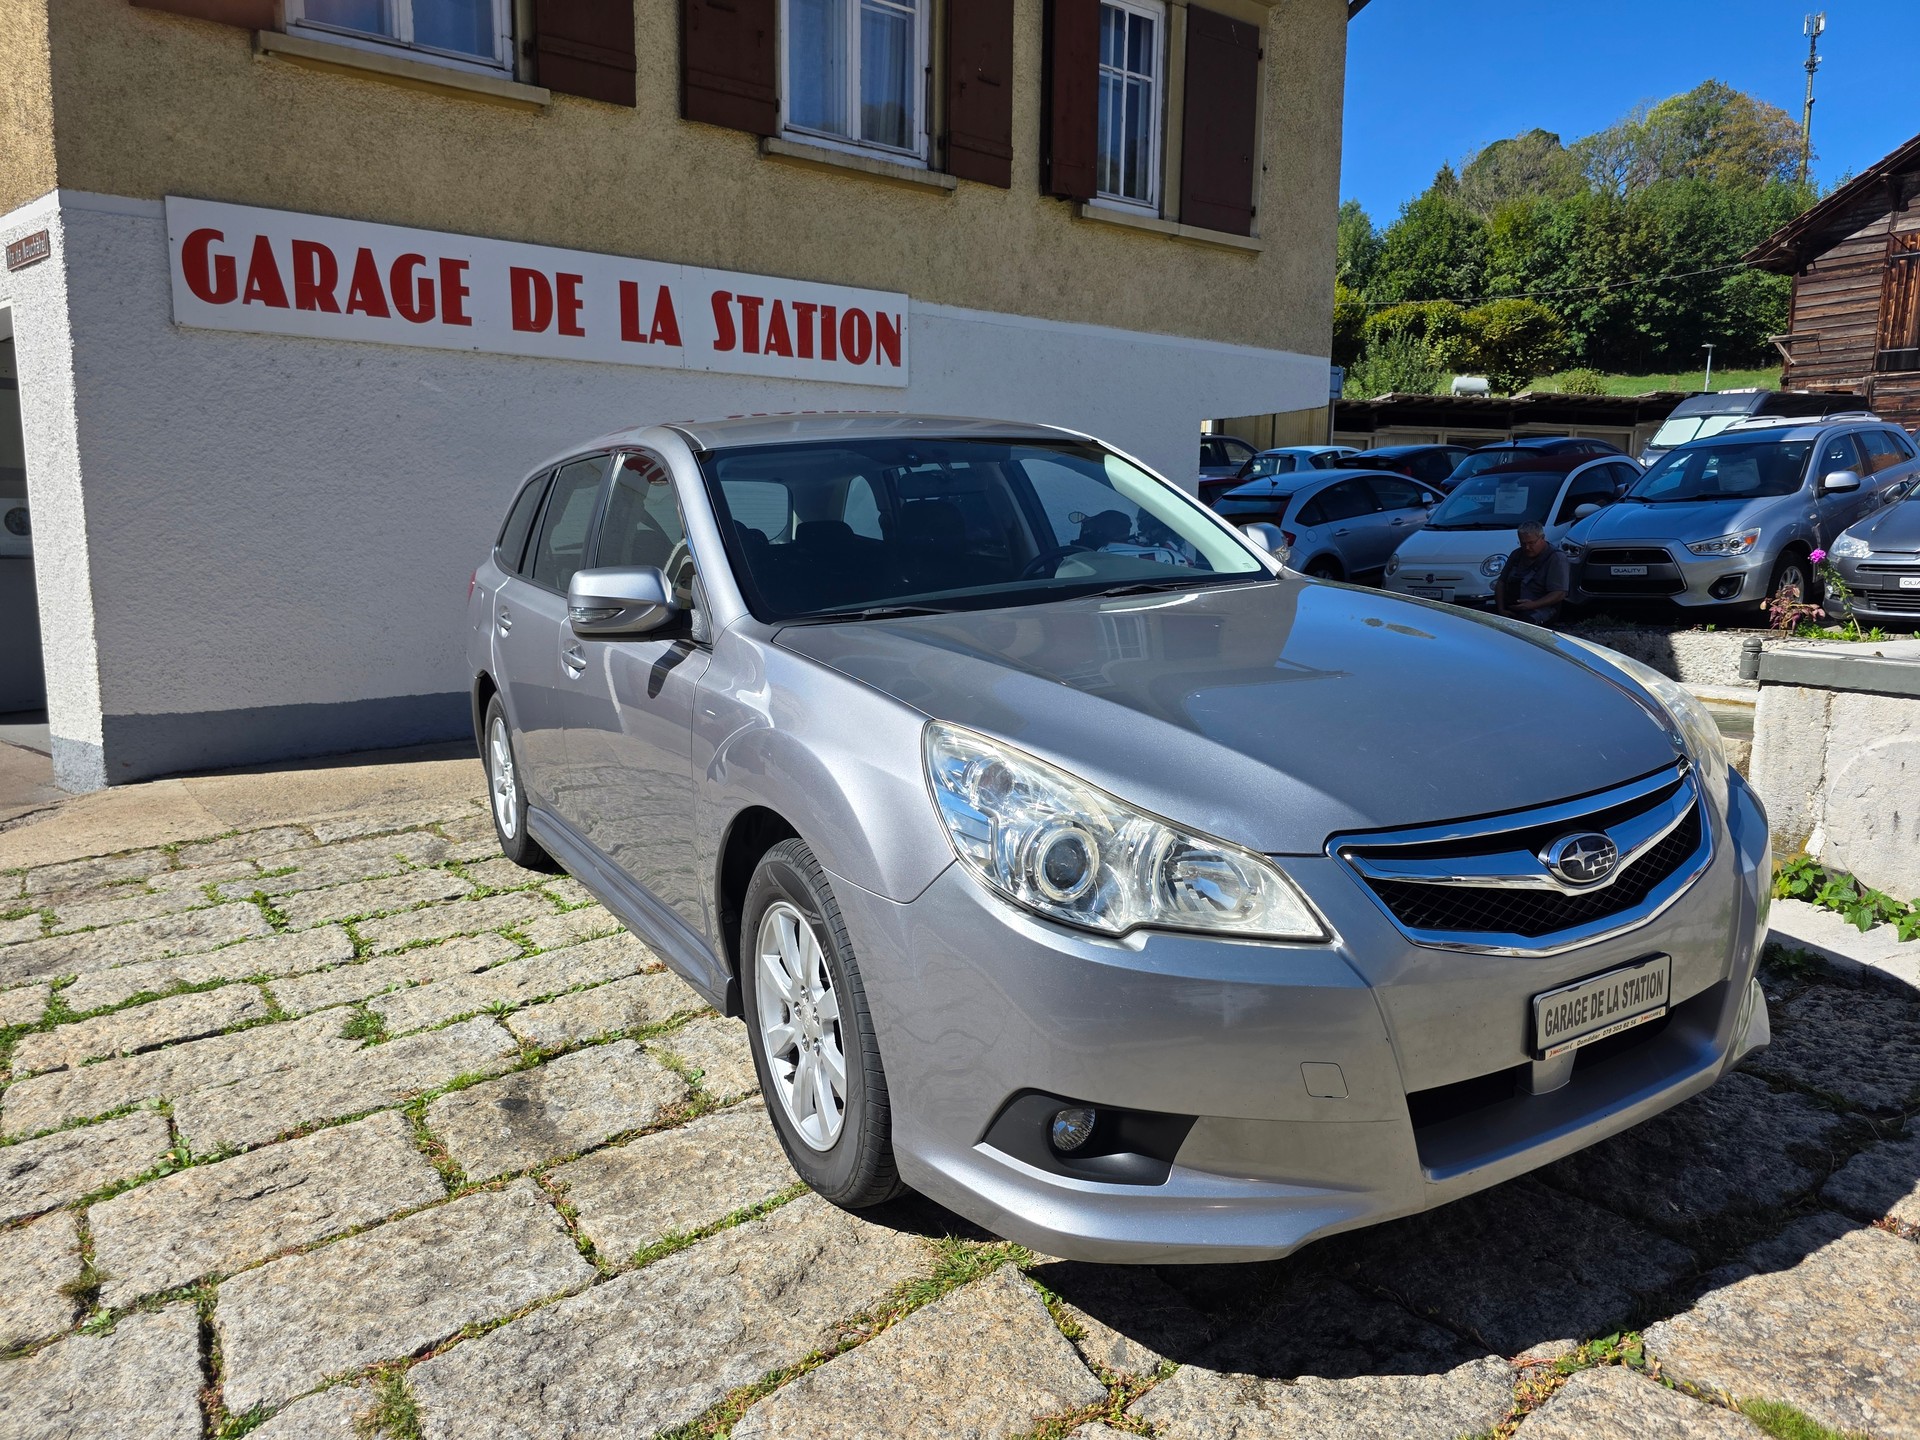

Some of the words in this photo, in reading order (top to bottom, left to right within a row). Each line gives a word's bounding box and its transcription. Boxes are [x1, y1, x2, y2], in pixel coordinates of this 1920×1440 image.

[182, 228, 472, 327] GARAGE
[510, 266, 585, 337] DE
[619, 280, 683, 347] LA
[711, 290, 901, 367] STATION
[1545, 996, 1588, 1037] GARAGE
[1591, 990, 1604, 1020] DE
[1607, 985, 1619, 1014] LA
[1622, 969, 1664, 1009] STATION
